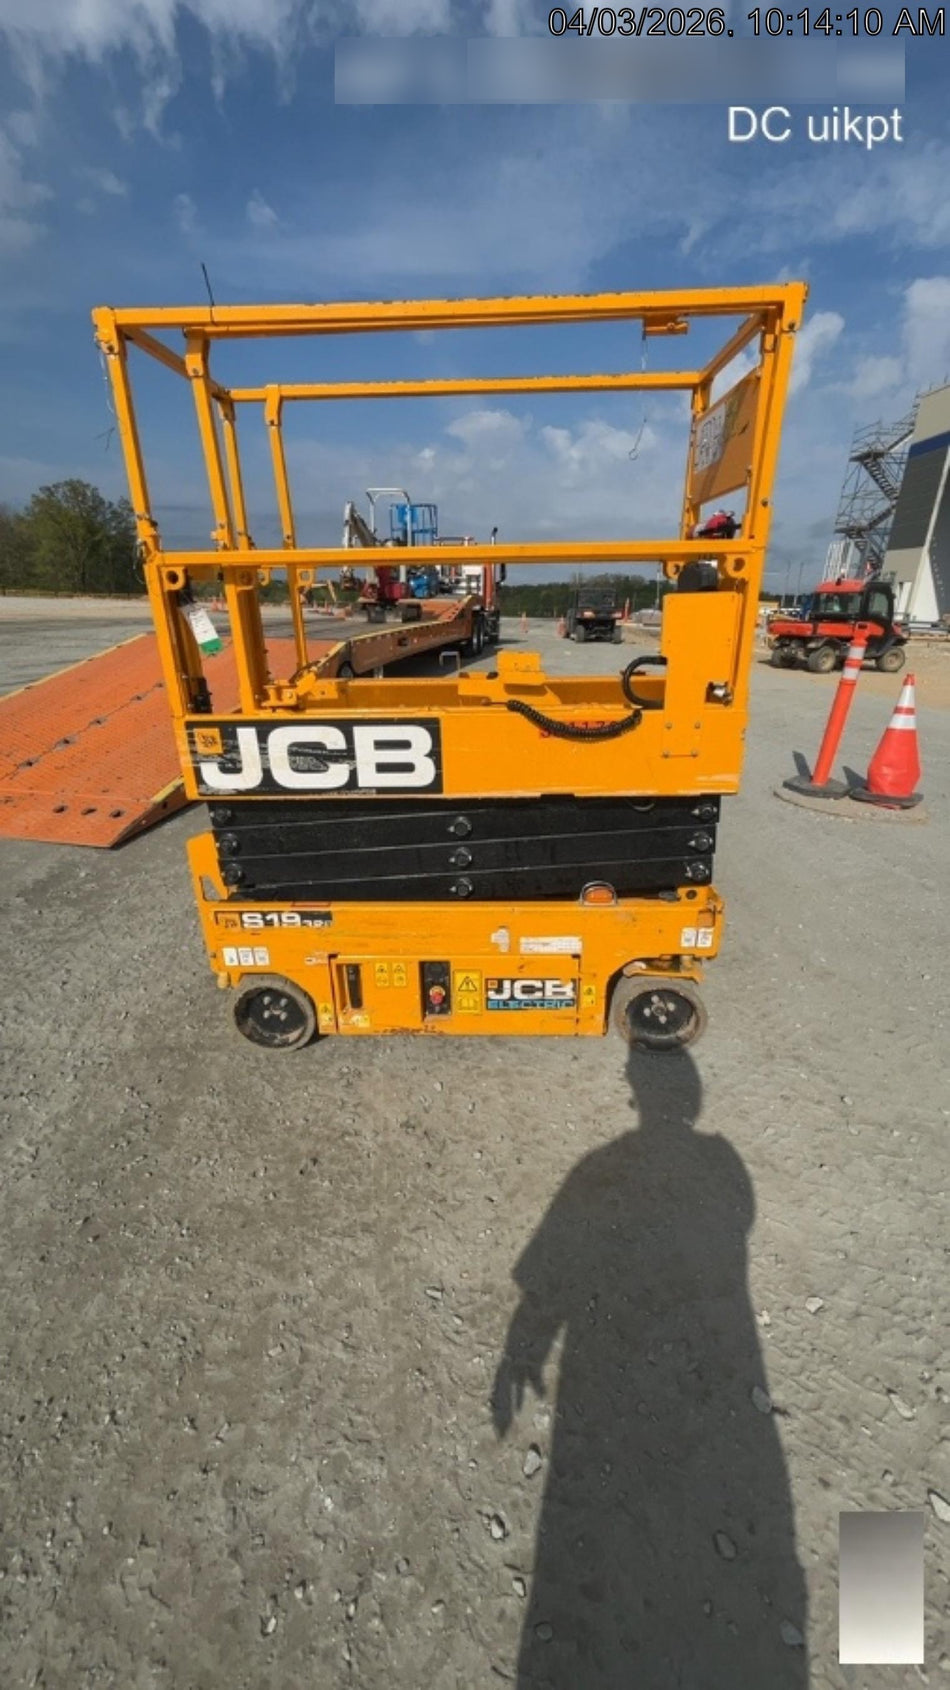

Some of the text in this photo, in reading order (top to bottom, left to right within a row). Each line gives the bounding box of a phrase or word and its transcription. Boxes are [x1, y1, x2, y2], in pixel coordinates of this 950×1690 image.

[200, 725, 436, 789] JCB
[488, 979, 574, 1000] JCB
[488, 1000, 574, 1009] ELECTRIC
